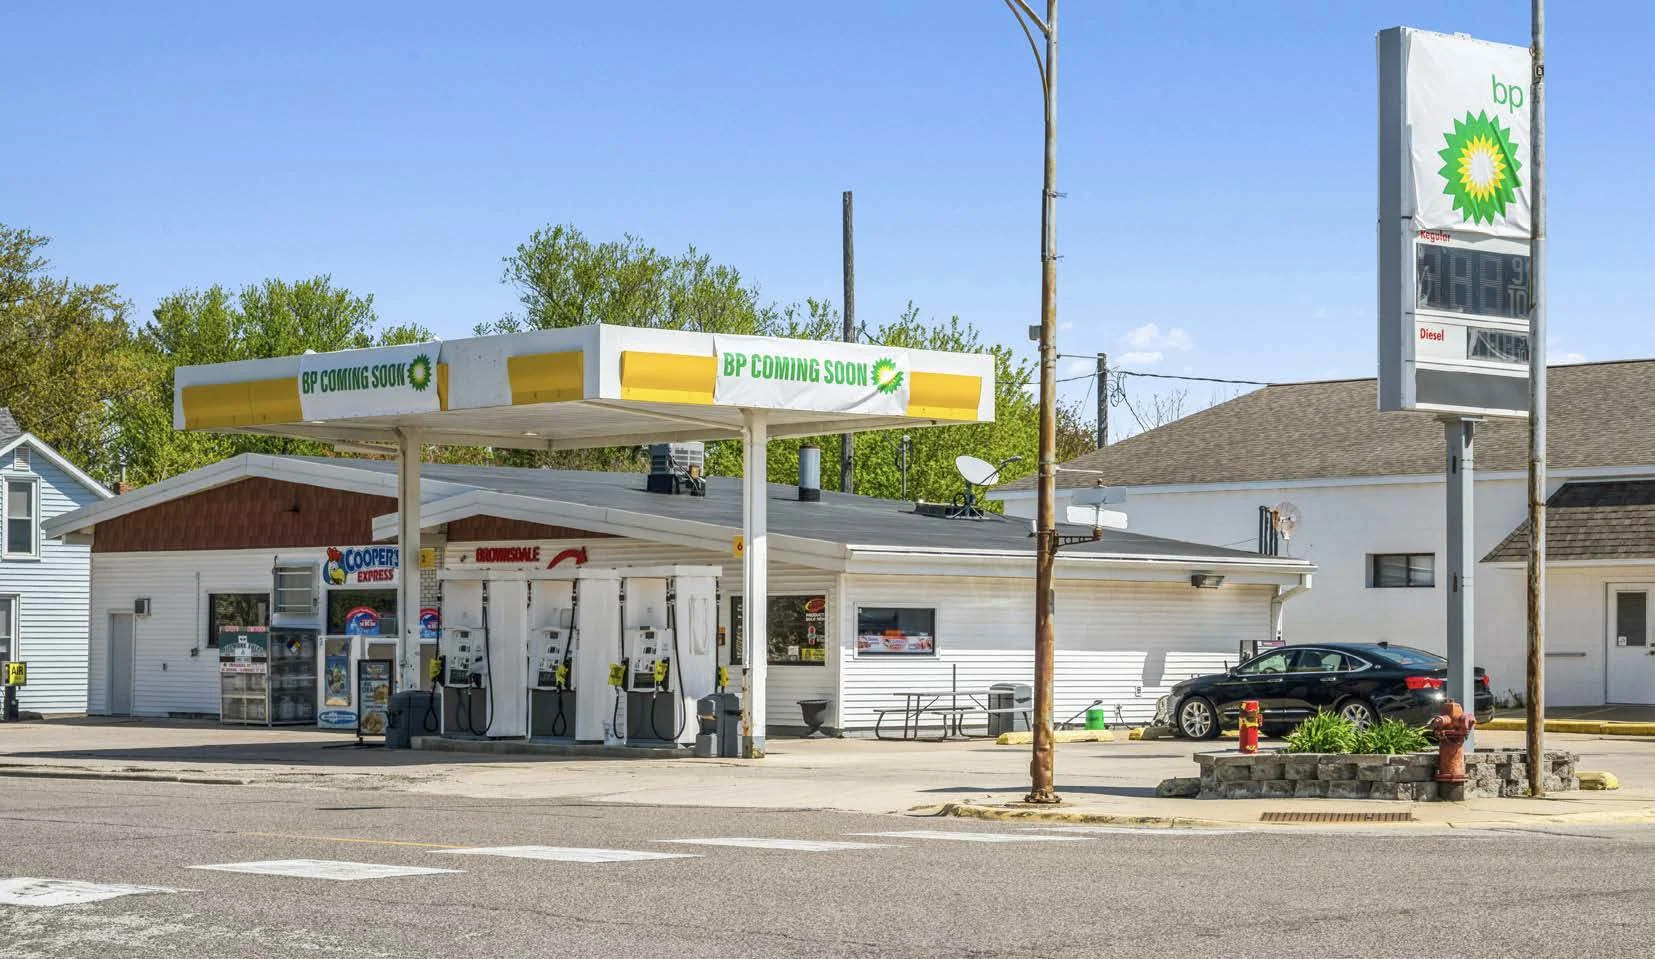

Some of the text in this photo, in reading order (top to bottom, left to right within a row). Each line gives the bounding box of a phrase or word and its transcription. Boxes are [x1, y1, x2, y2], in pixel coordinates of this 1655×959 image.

[1491, 73, 1523, 114] bp
[1419, 230, 1452, 244] Regular
[1419, 326, 1446, 342] Diesel
[723, 352, 868, 386] BP COMING SOON
[302, 362, 406, 394] BP COMING SOON
[475, 546, 541, 563] BROWNSDALE
[357, 568, 394, 583] EXPRESS
[11, 665, 24, 675] AIR
